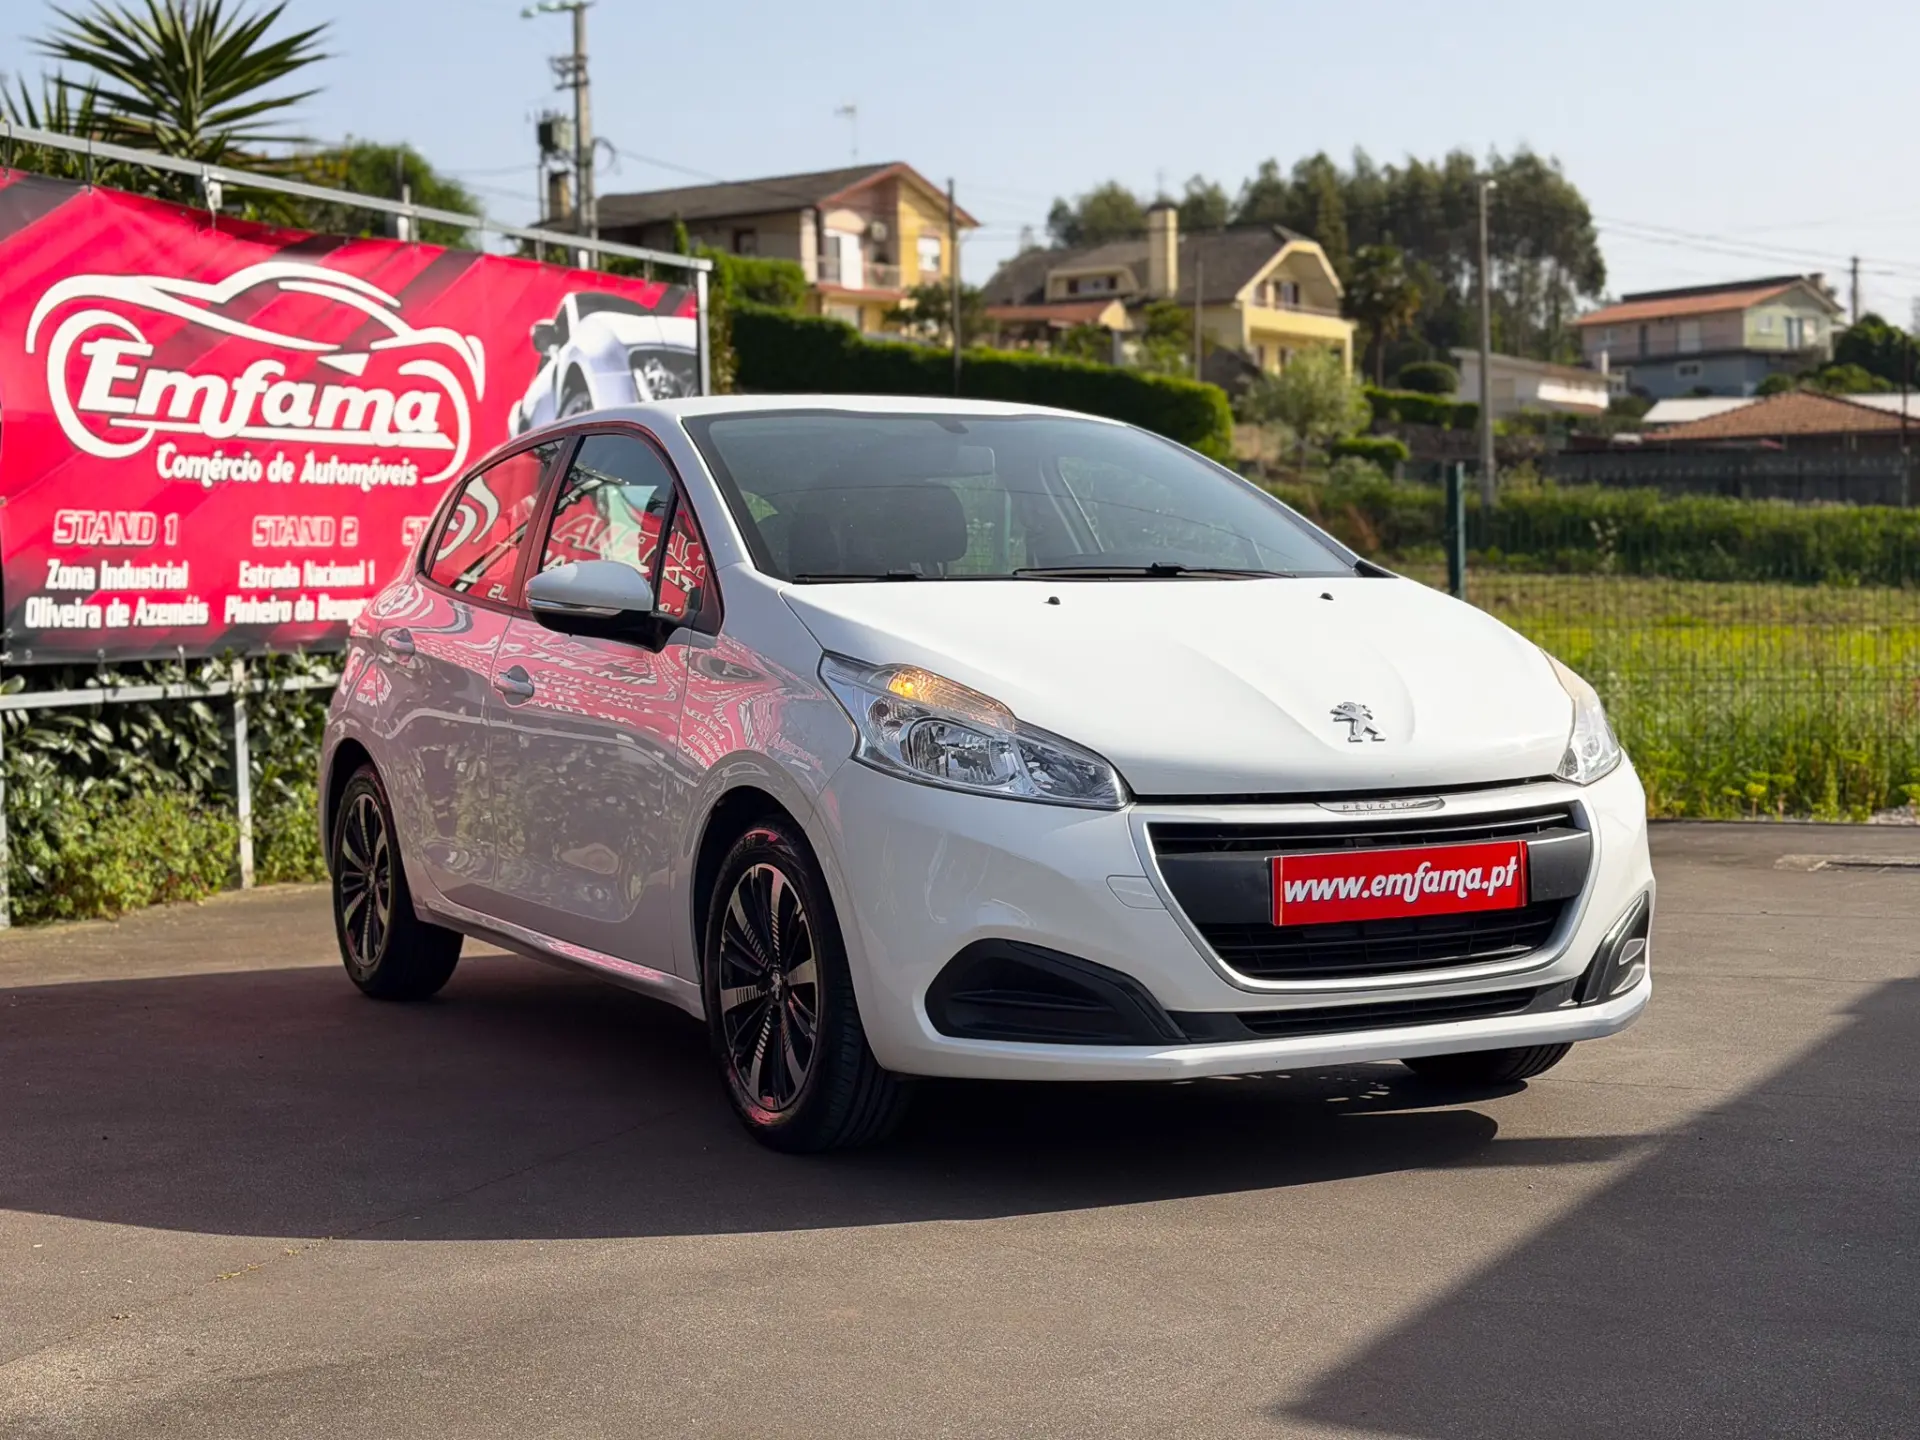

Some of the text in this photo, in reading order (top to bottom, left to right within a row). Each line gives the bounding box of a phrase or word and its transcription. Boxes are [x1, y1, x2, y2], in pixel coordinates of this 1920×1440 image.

[78, 337, 443, 446] Emfama
[157, 442, 418, 491] Comércio de Automóveis
[52, 509, 179, 546] STAND 1
[252, 515, 359, 547] STAND 2
[45, 558, 189, 590] Zona Industrial
[239, 560, 375, 588] Estrada Nacional 1
[25, 595, 209, 628] Oliveira de Azeméis
[224, 595, 292, 624] Pinheiro
[295, 594, 315, 622] da
[1284, 856, 1517, 903] www.emfama.pt
